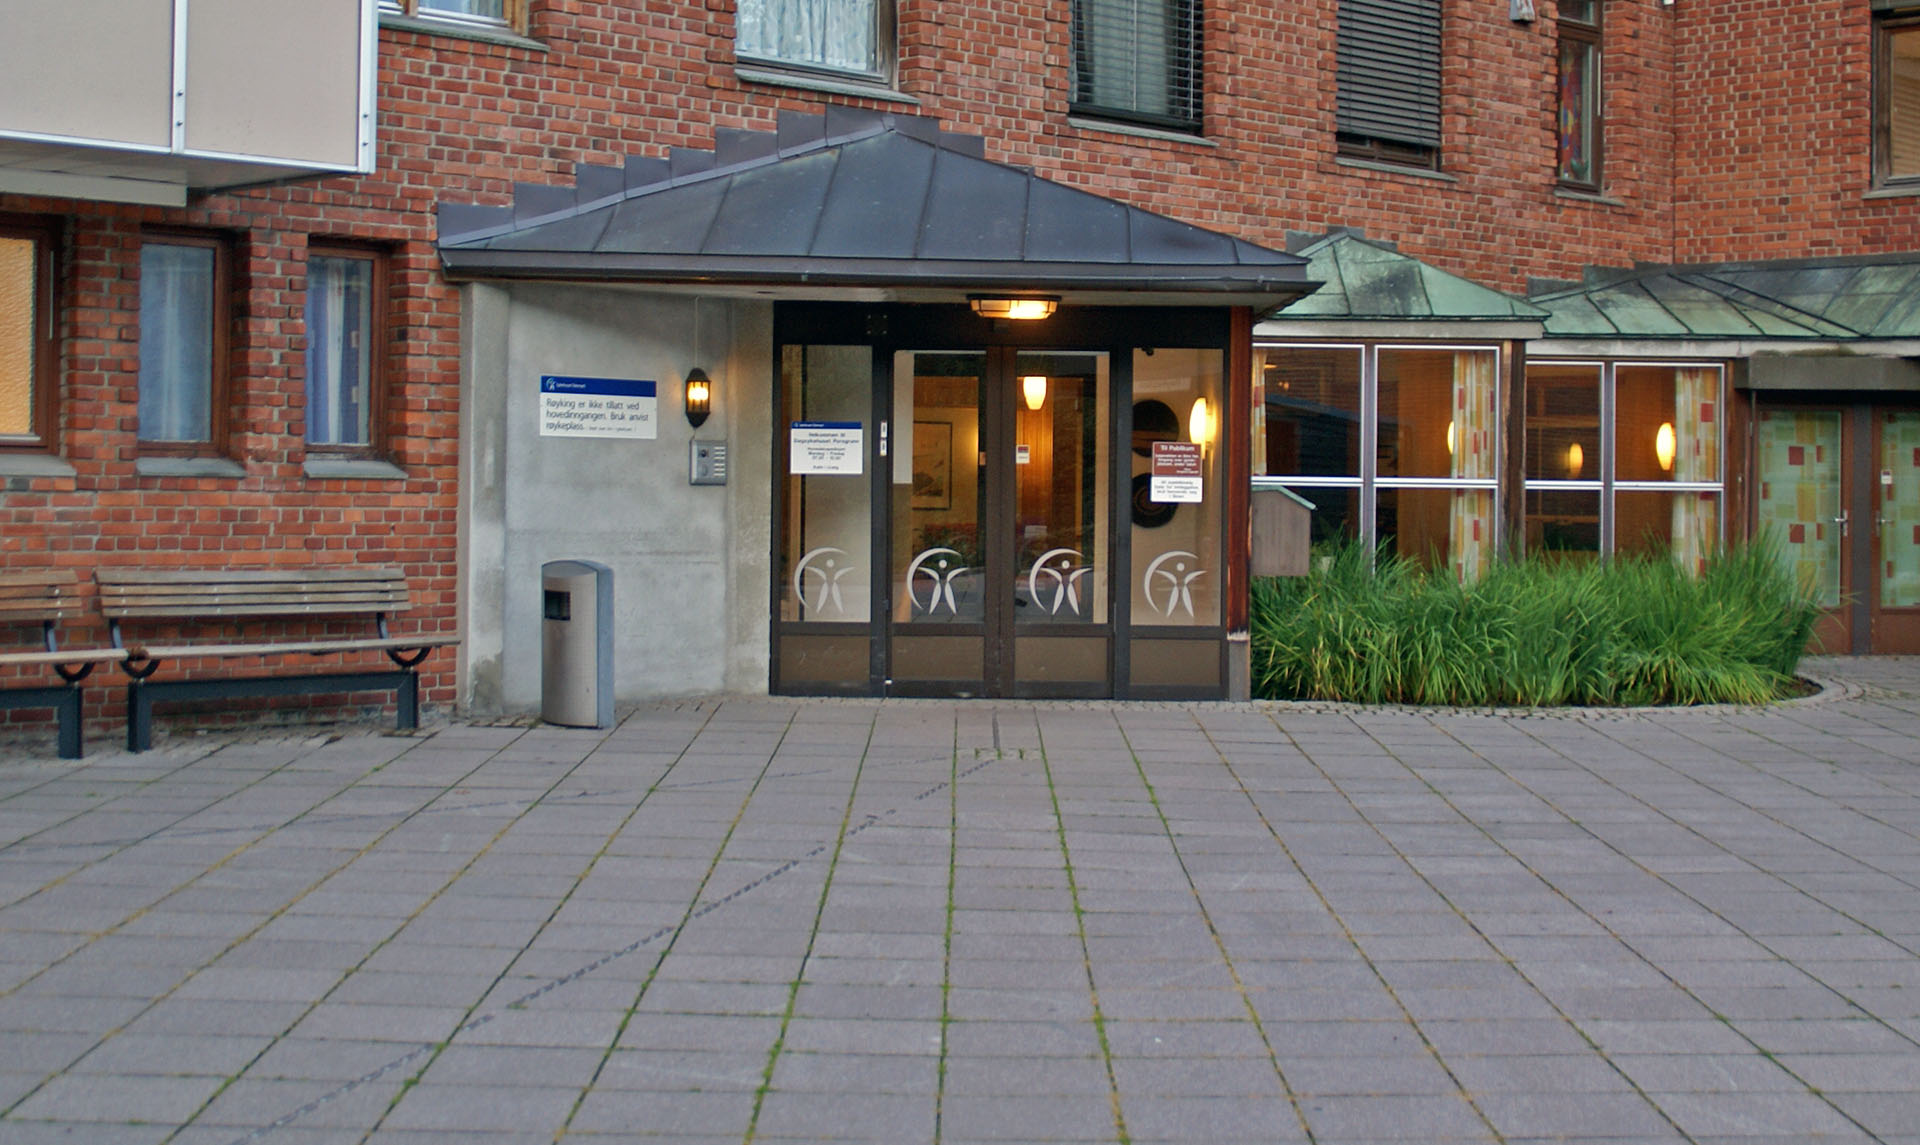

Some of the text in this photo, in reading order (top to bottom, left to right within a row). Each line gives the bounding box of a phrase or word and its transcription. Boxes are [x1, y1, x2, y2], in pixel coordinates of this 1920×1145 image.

[546, 398, 575, 410] Røyking
[589, 400, 602, 408] ikke
[606, 400, 623, 409] tillatt
[627, 402, 640, 410] ved
[610, 412, 625, 420] Bruk
